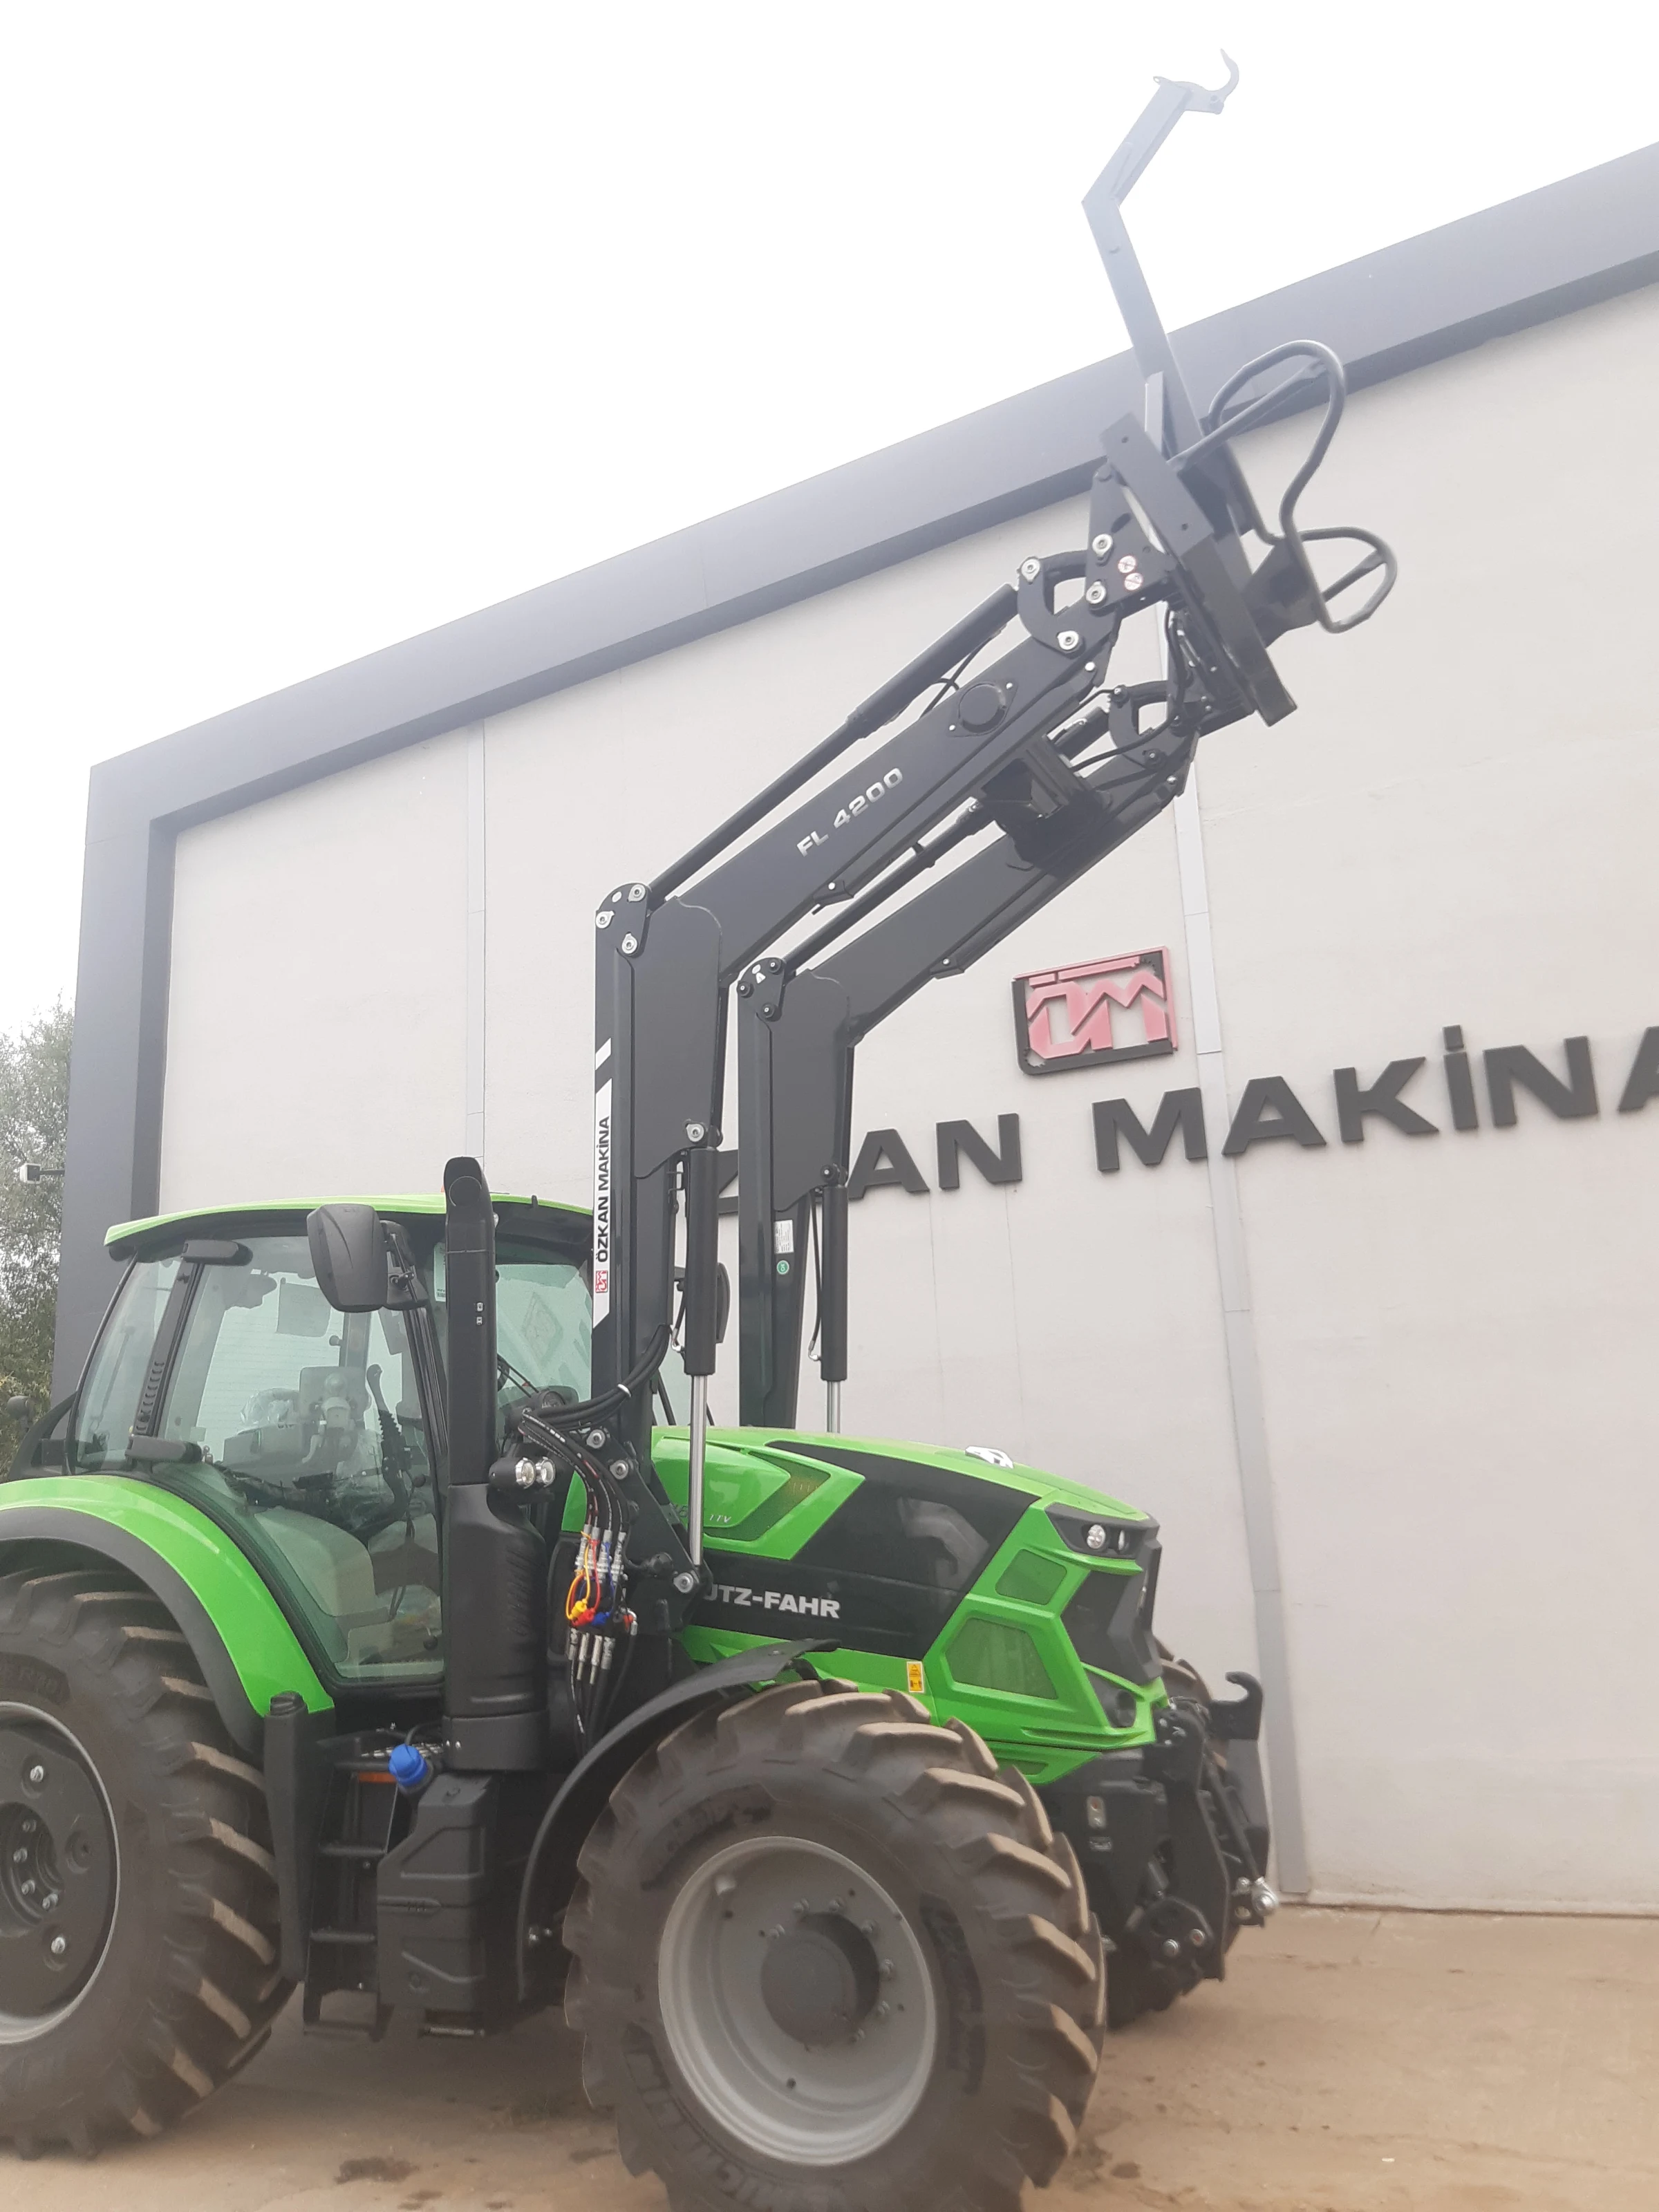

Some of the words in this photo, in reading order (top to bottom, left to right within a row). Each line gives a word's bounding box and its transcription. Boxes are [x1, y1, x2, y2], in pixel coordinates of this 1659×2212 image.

[797, 831, 830, 857] FL
[834, 768, 903, 829] 4200
[597, 1115, 610, 1191] MAKİNA
[596, 1196, 609, 1263] ÖZKAN
[704, 1583, 840, 1619] UTZ-FAHR
